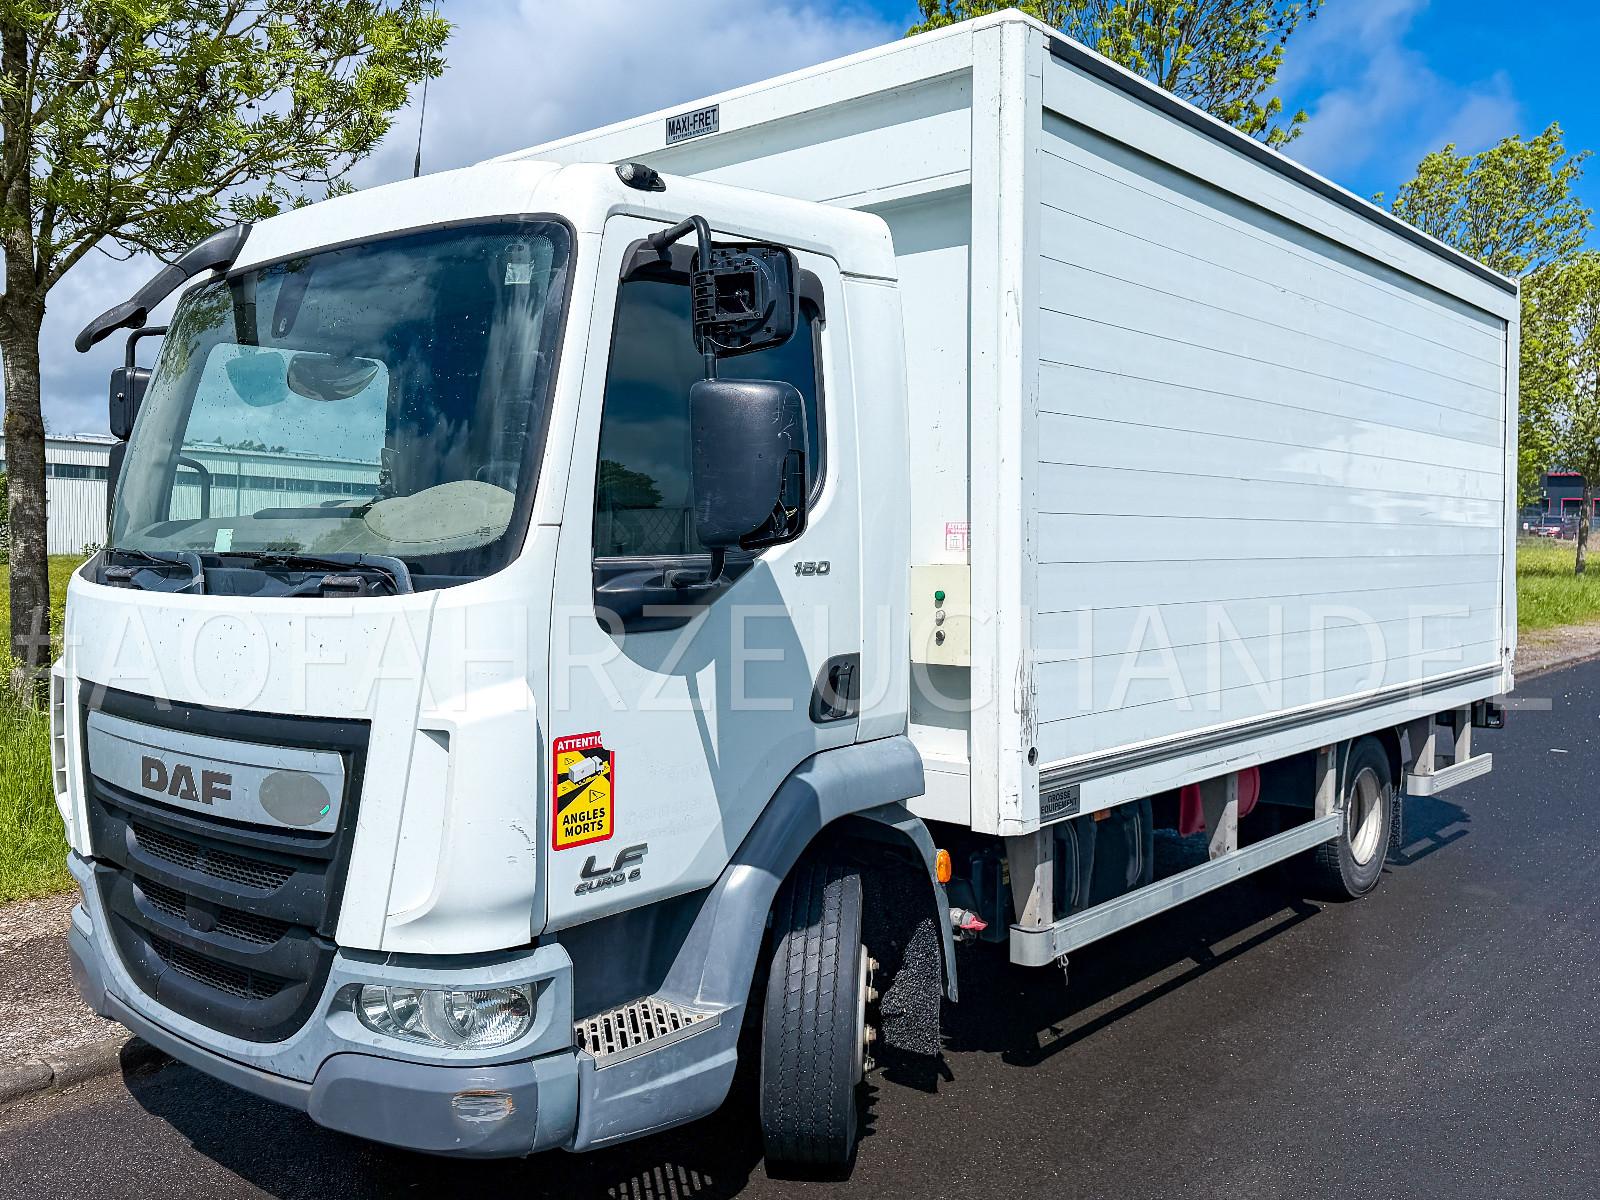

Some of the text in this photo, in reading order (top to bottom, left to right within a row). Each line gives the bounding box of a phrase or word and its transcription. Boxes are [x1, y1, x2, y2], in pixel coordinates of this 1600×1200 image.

[668, 109, 716, 137] MAXI-FRET
[794, 561, 831, 576] 180
[141, 755, 232, 805] DAF
[563, 807, 606, 826] ANGLES
[565, 820, 604, 837] MORTS
[581, 843, 648, 879] LF
[575, 868, 641, 895] EURO 6
